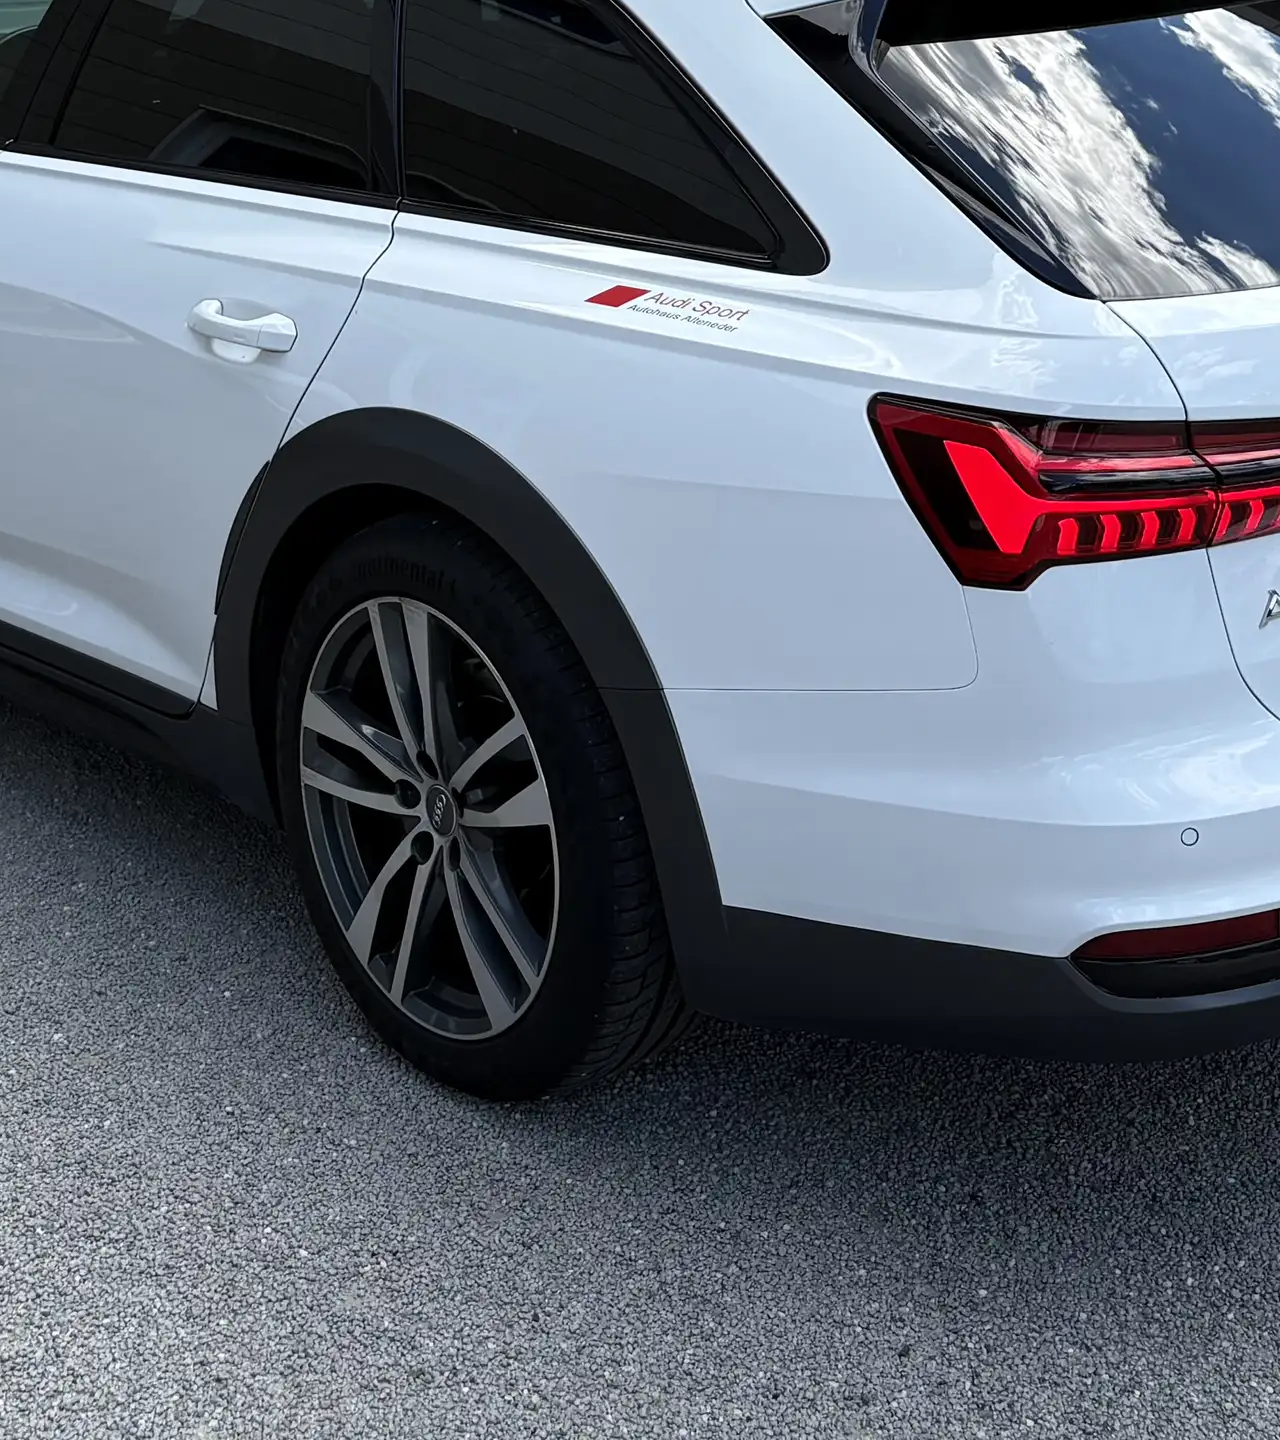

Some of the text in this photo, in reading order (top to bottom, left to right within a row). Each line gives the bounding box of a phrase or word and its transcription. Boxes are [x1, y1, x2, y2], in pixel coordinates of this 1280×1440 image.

[627, 304, 739, 333] Autohaus Alteneder
[644, 292, 751, 322] Audi Sport
